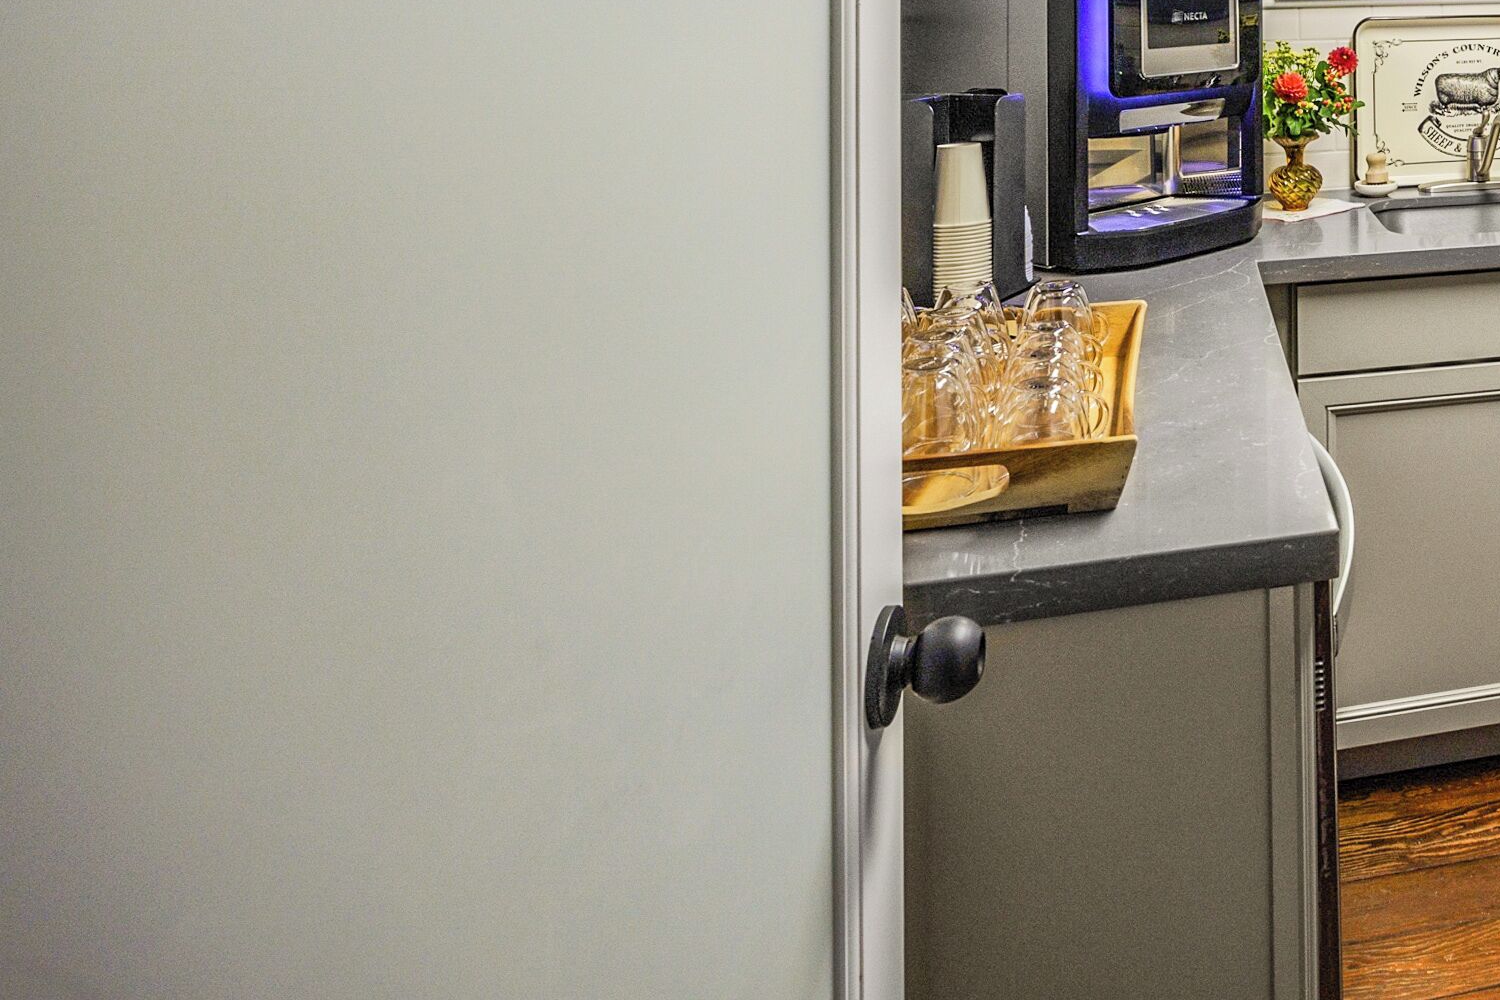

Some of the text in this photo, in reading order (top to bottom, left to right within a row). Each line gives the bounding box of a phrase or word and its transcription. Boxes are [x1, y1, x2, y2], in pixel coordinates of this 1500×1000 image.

[1183, 11, 1208, 21] NECTA
[1413, 51, 1449, 97] WILSON'S
[1424, 126, 1454, 149] SHEEP
